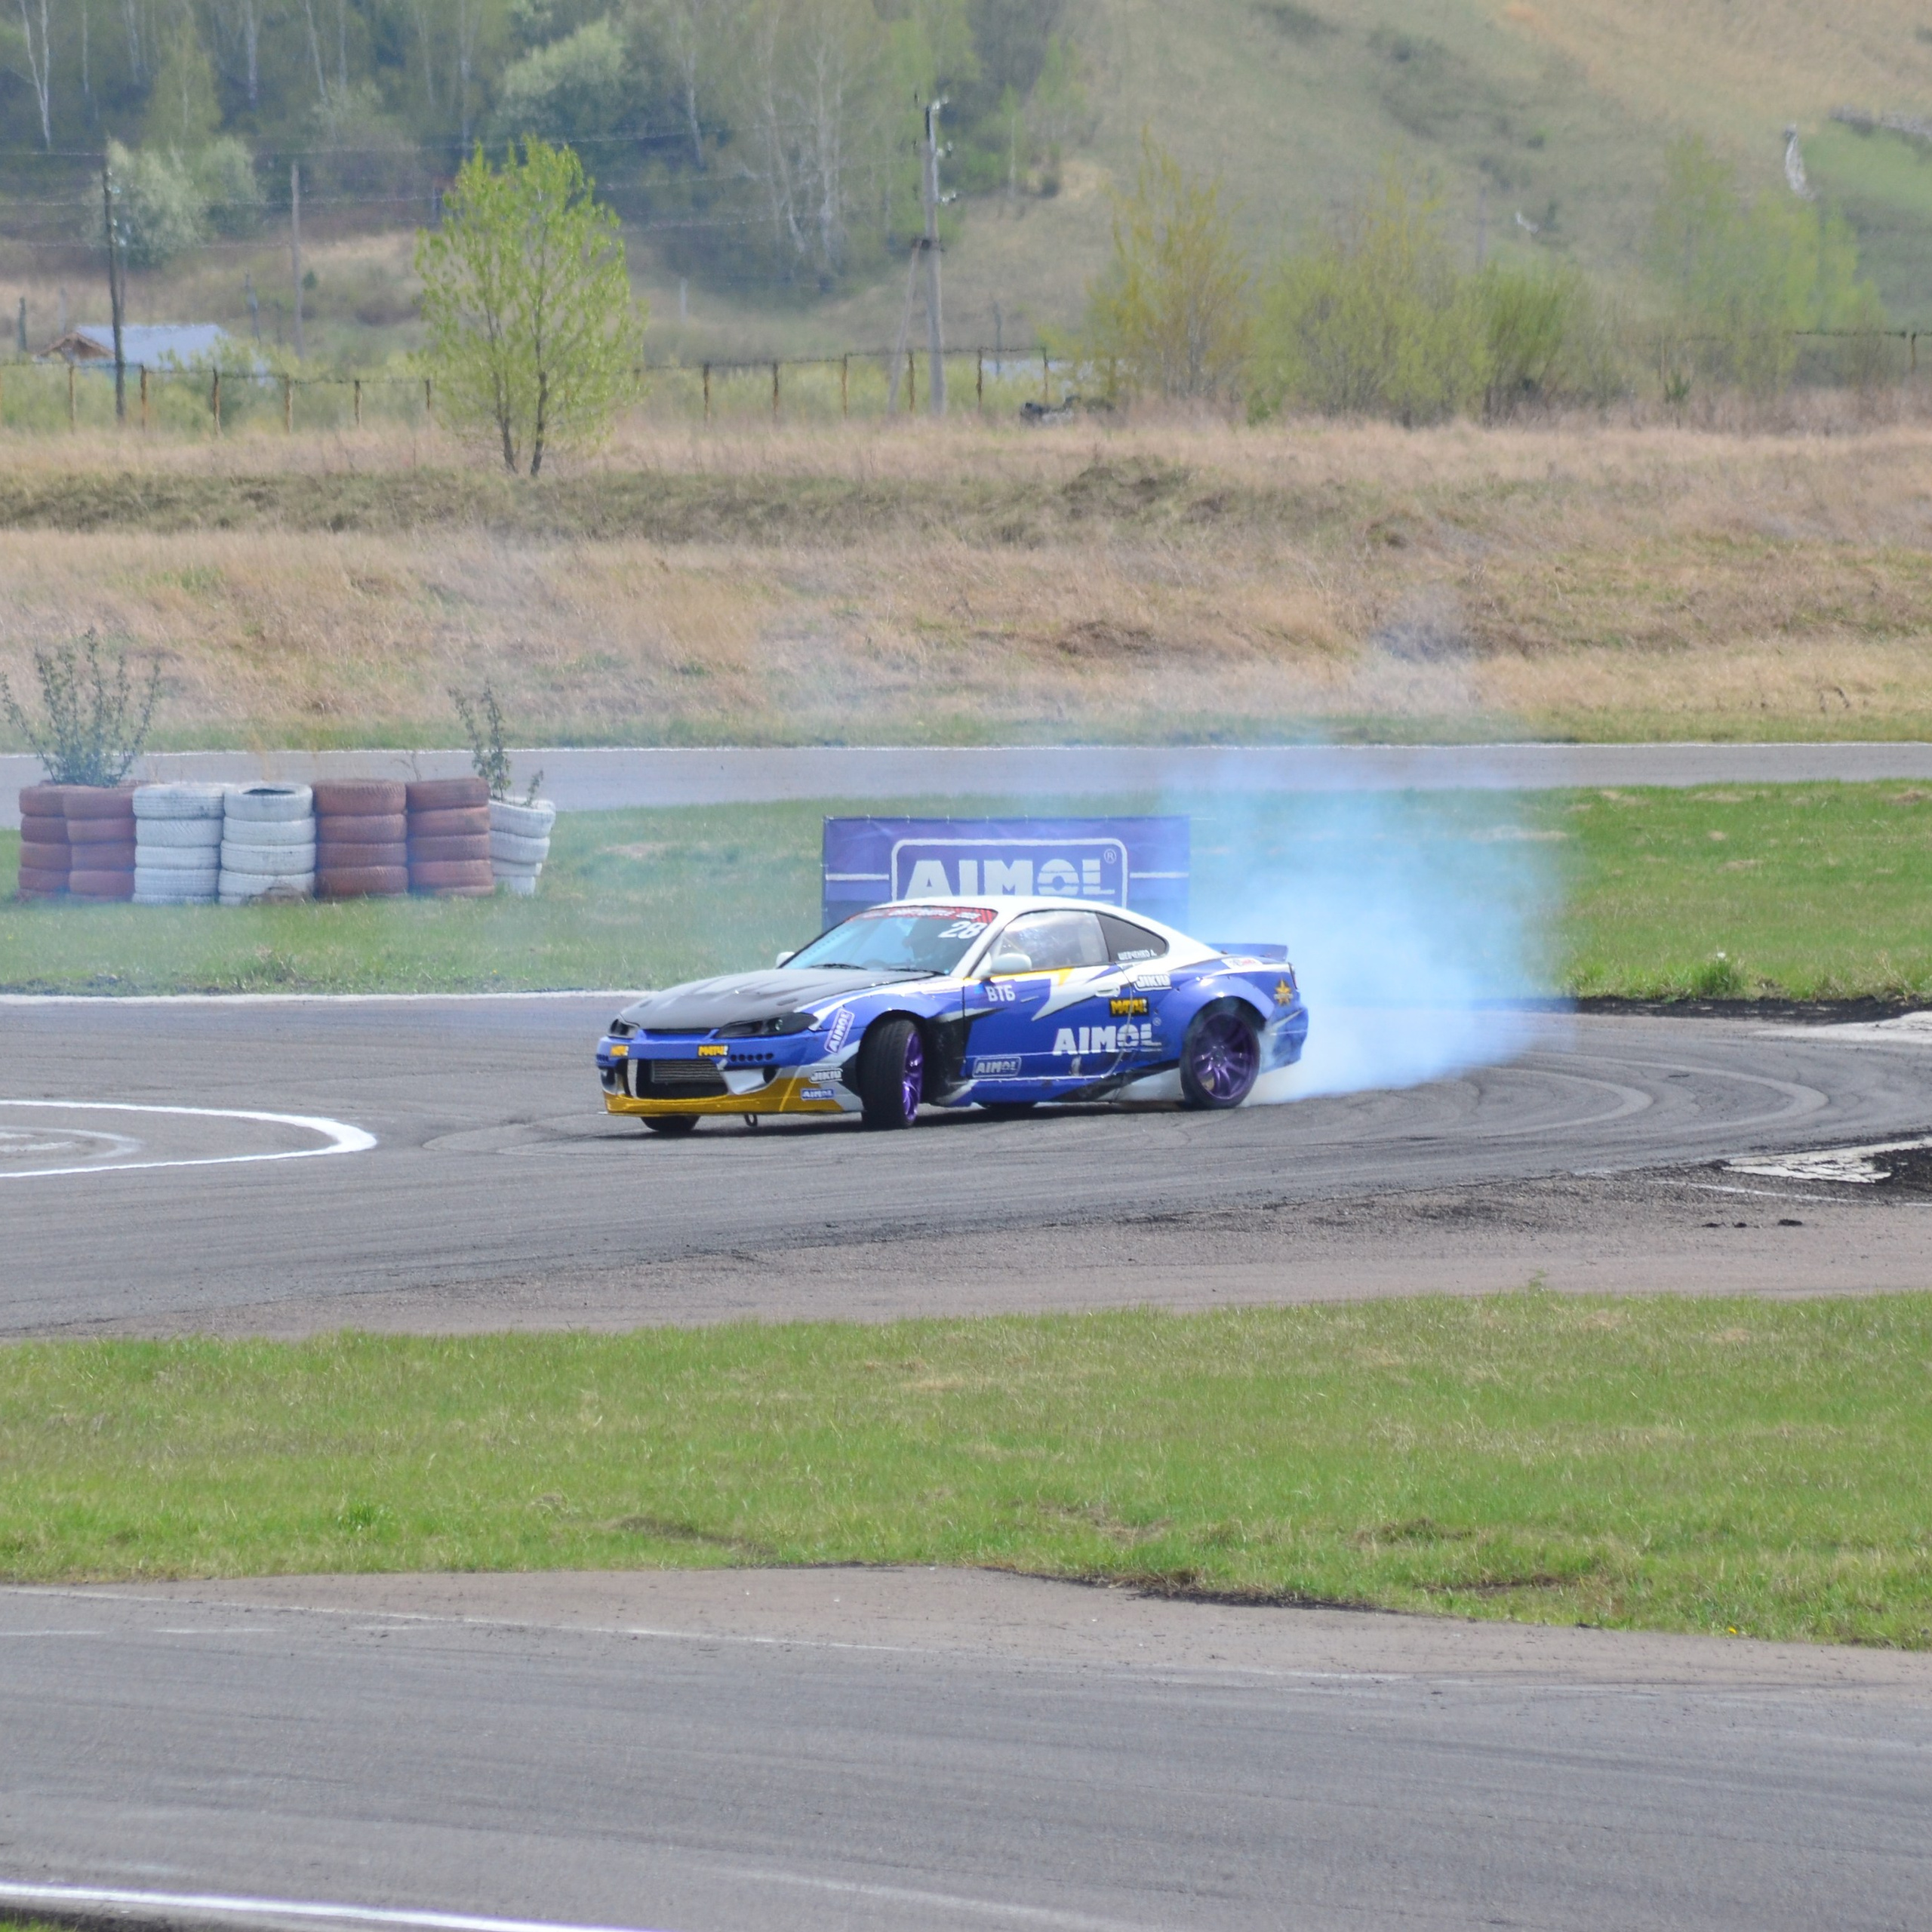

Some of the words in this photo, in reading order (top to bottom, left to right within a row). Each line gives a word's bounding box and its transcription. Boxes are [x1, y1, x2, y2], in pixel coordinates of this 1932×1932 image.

[904, 859, 1115, 904] AIMOL
[937, 920, 988, 940] 28
[985, 985, 1016, 1001] ВТБ
[828, 1011, 850, 1053] AIMOL
[1053, 1023, 1162, 1056] AIMOL
[976, 1061, 1017, 1073] AIMOL
